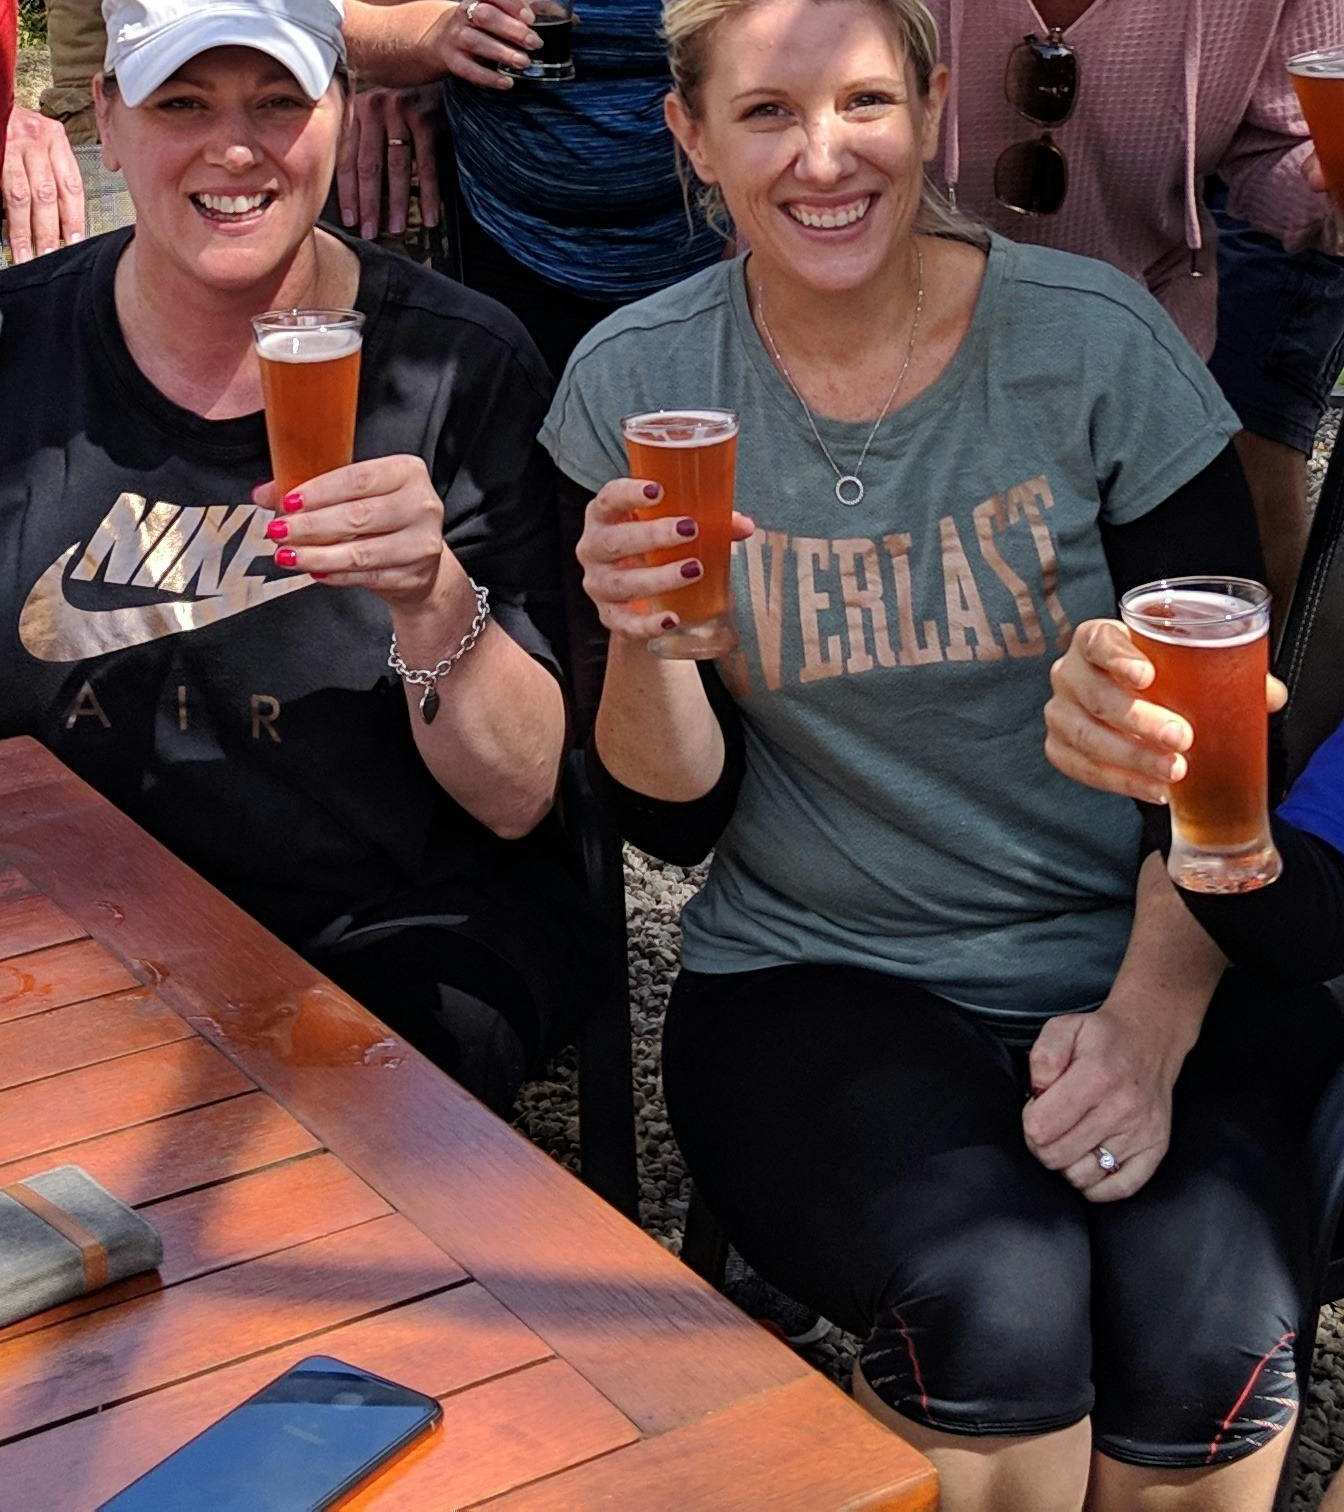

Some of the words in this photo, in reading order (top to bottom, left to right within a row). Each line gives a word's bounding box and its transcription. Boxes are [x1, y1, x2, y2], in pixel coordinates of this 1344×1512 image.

[70, 492, 280, 596] NIKE
[730, 474, 1072, 691] VERLAST
[65, 681, 282, 744] AIR
